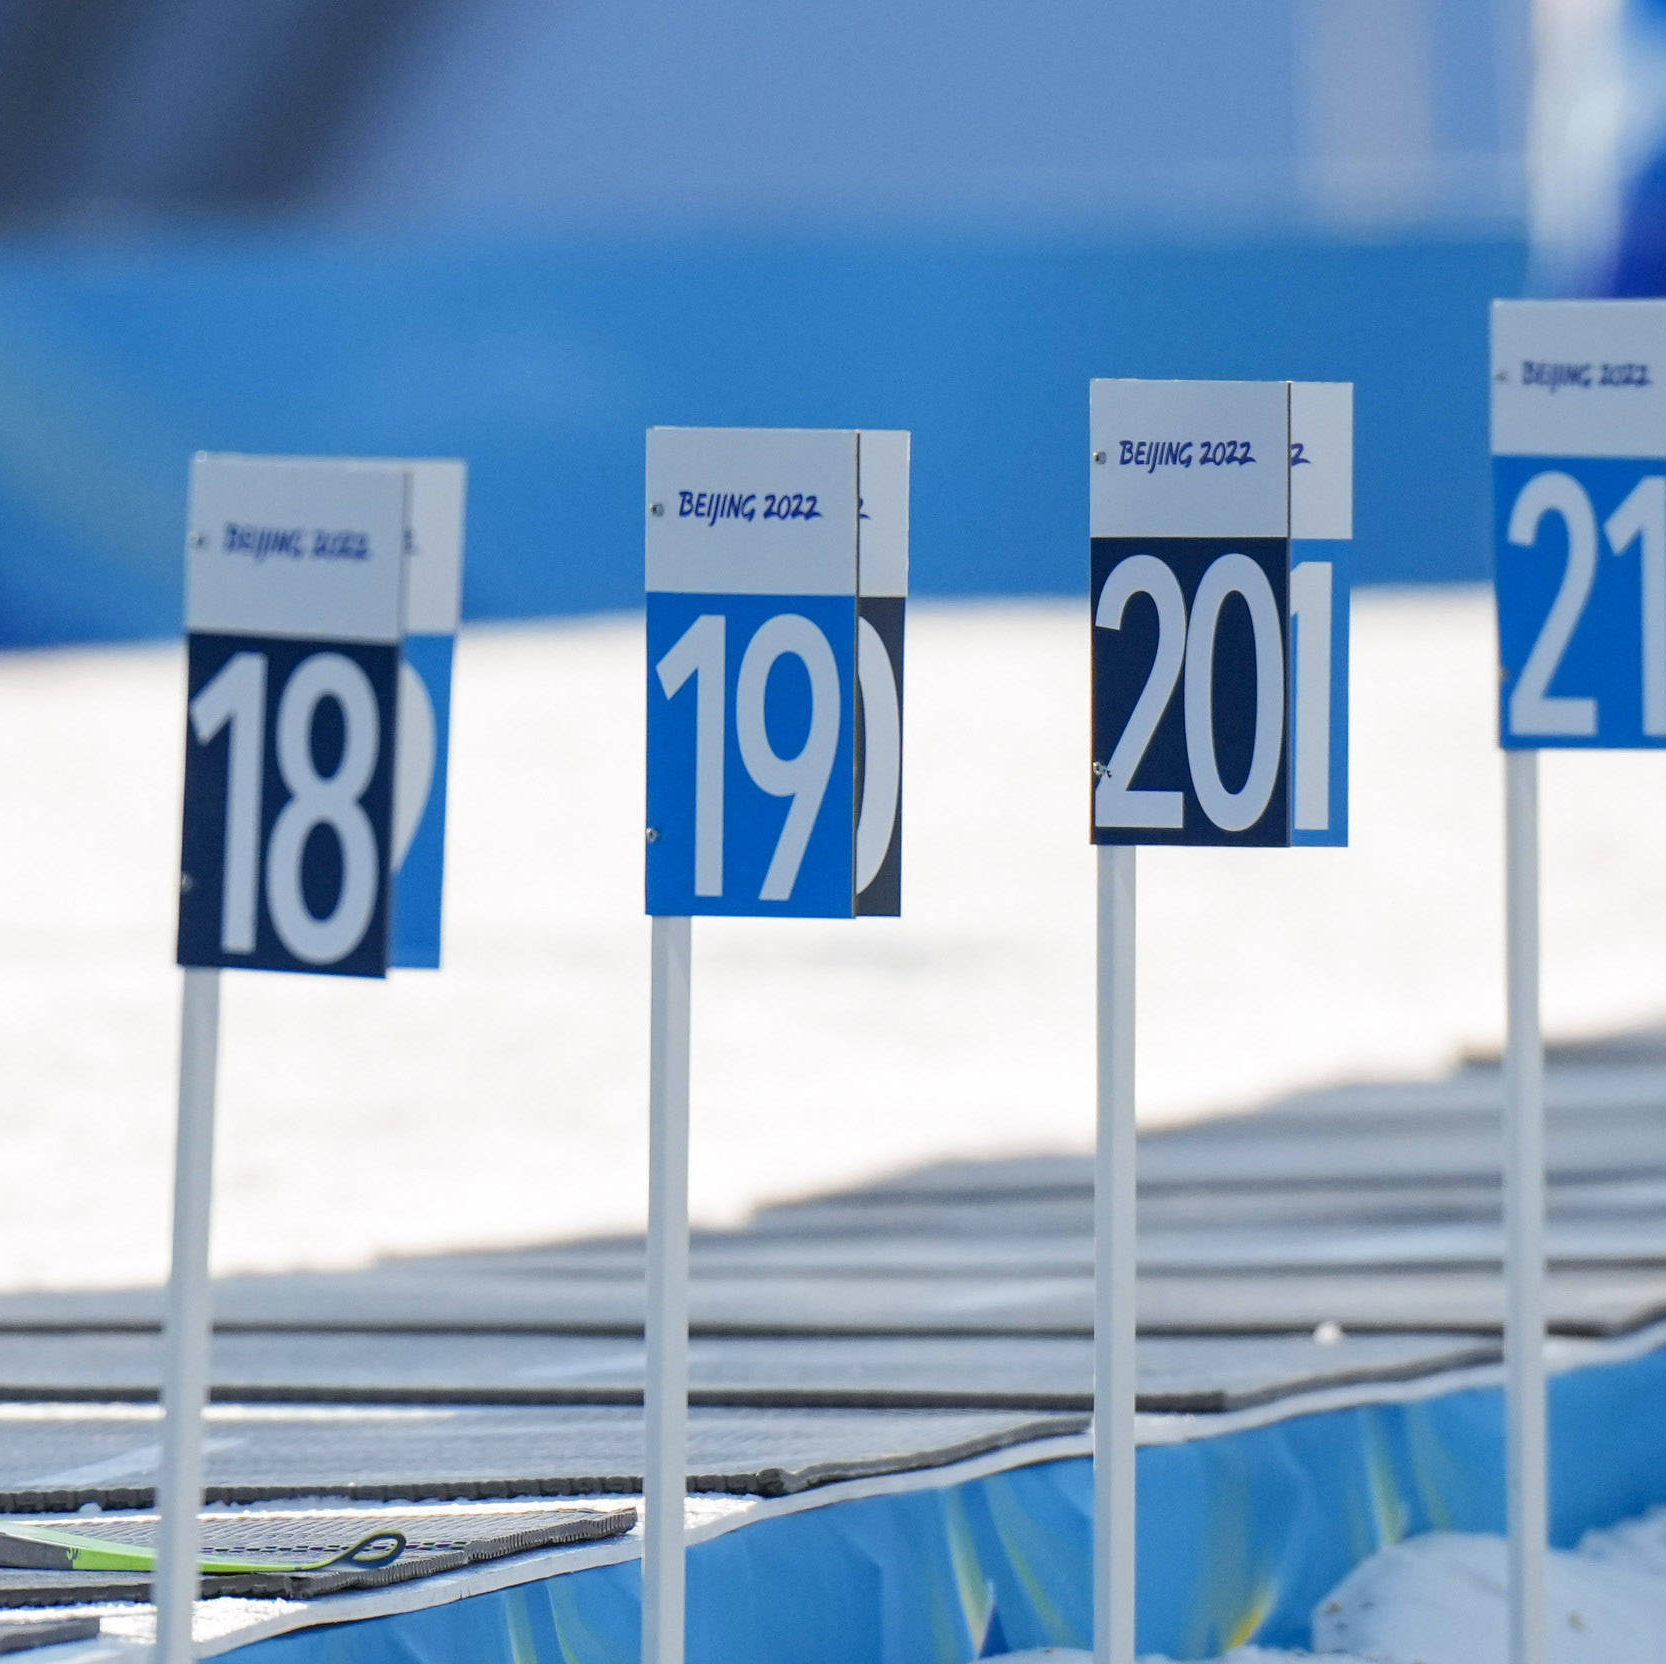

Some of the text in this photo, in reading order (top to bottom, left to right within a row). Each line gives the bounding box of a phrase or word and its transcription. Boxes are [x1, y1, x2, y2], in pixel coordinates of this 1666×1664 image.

[679, 491, 757, 527] BEIJING
[763, 494, 823, 521] 2022
[1119, 440, 1193, 474] BEIJING
[1199, 440, 1256, 467] 2022
[189, 650, 380, 966] 18
[655, 613, 841, 901] 19
[1095, 553, 1284, 832] 20
